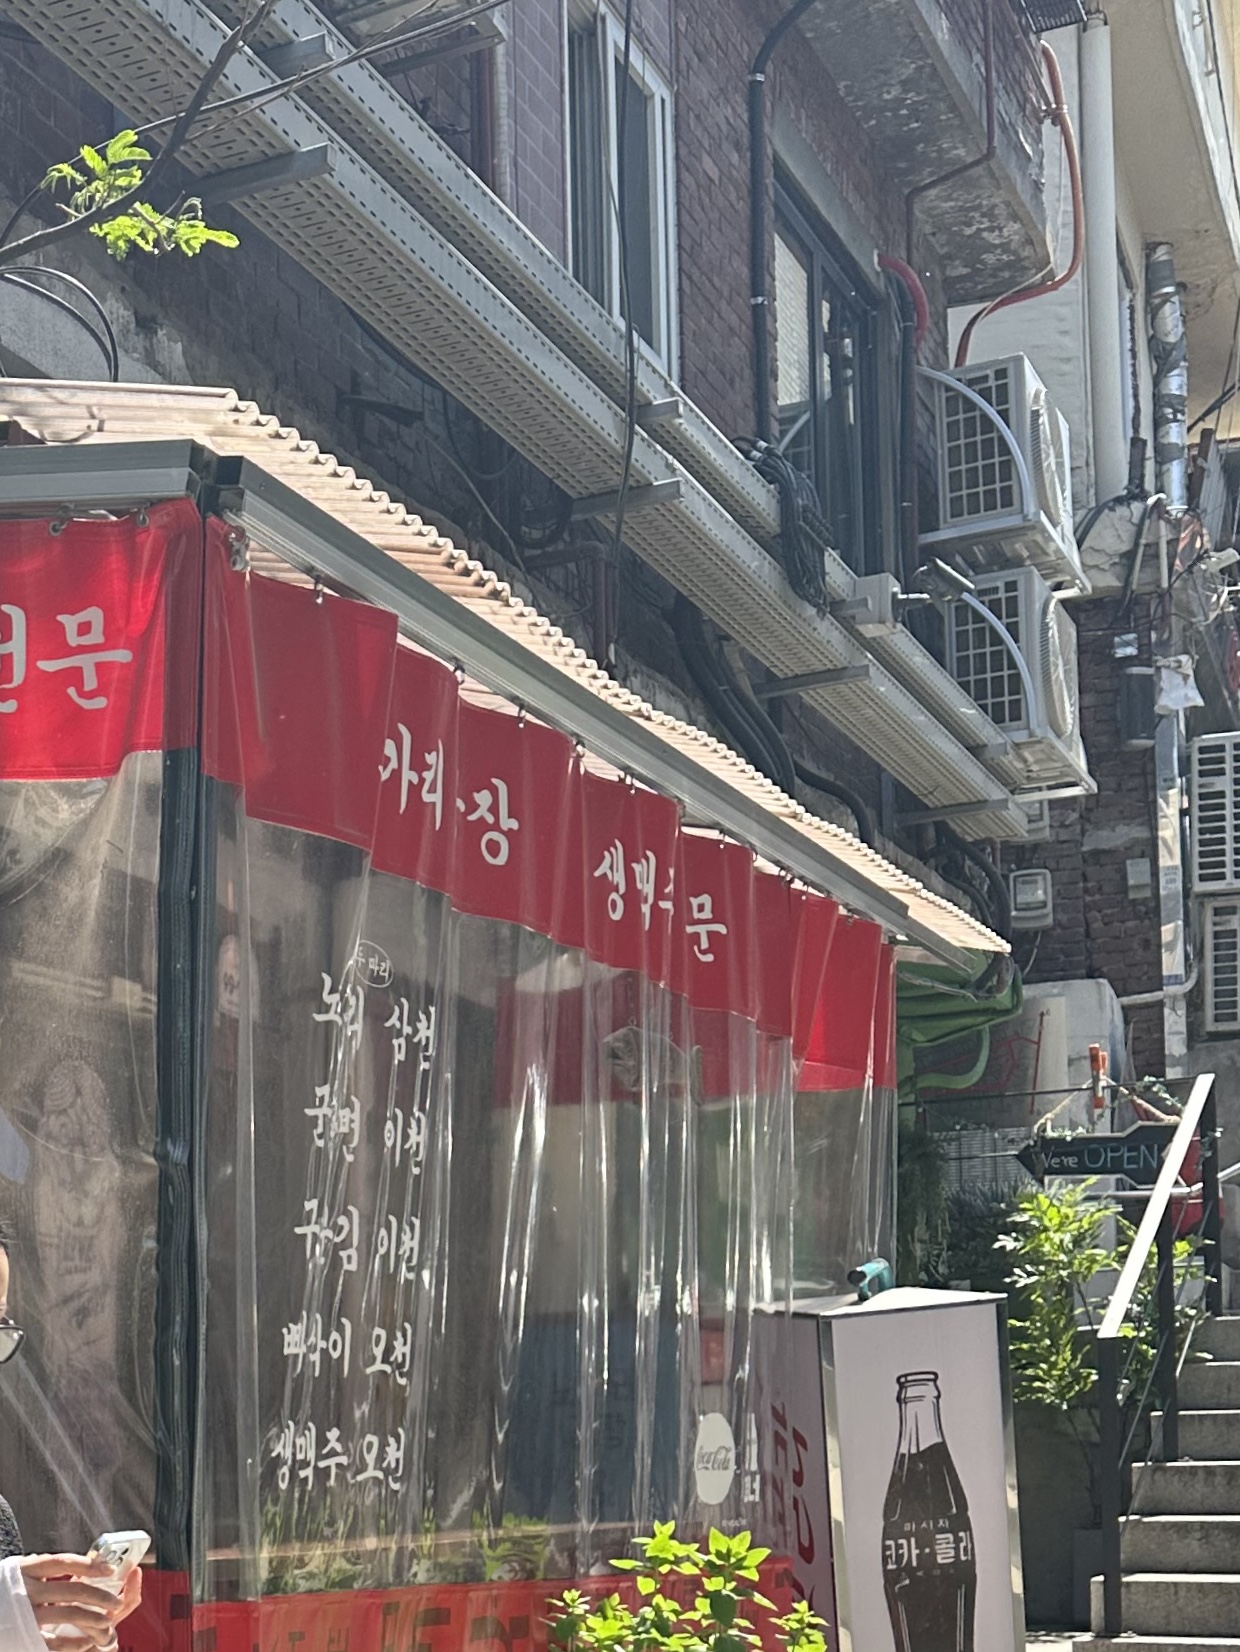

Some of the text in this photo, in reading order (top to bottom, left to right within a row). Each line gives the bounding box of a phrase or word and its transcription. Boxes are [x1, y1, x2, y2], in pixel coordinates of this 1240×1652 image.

[384, 997, 436, 1072] 삼천
[383, 1107, 427, 1176] 이천
[1084, 1143, 1159, 1169] OPEN
[377, 1214, 421, 1281] 이천
[365, 1321, 413, 1386] 오천
[271, 1420, 406, 1491] 생맥주 오천
[884, 1530, 973, 1571] 코카·콜라
